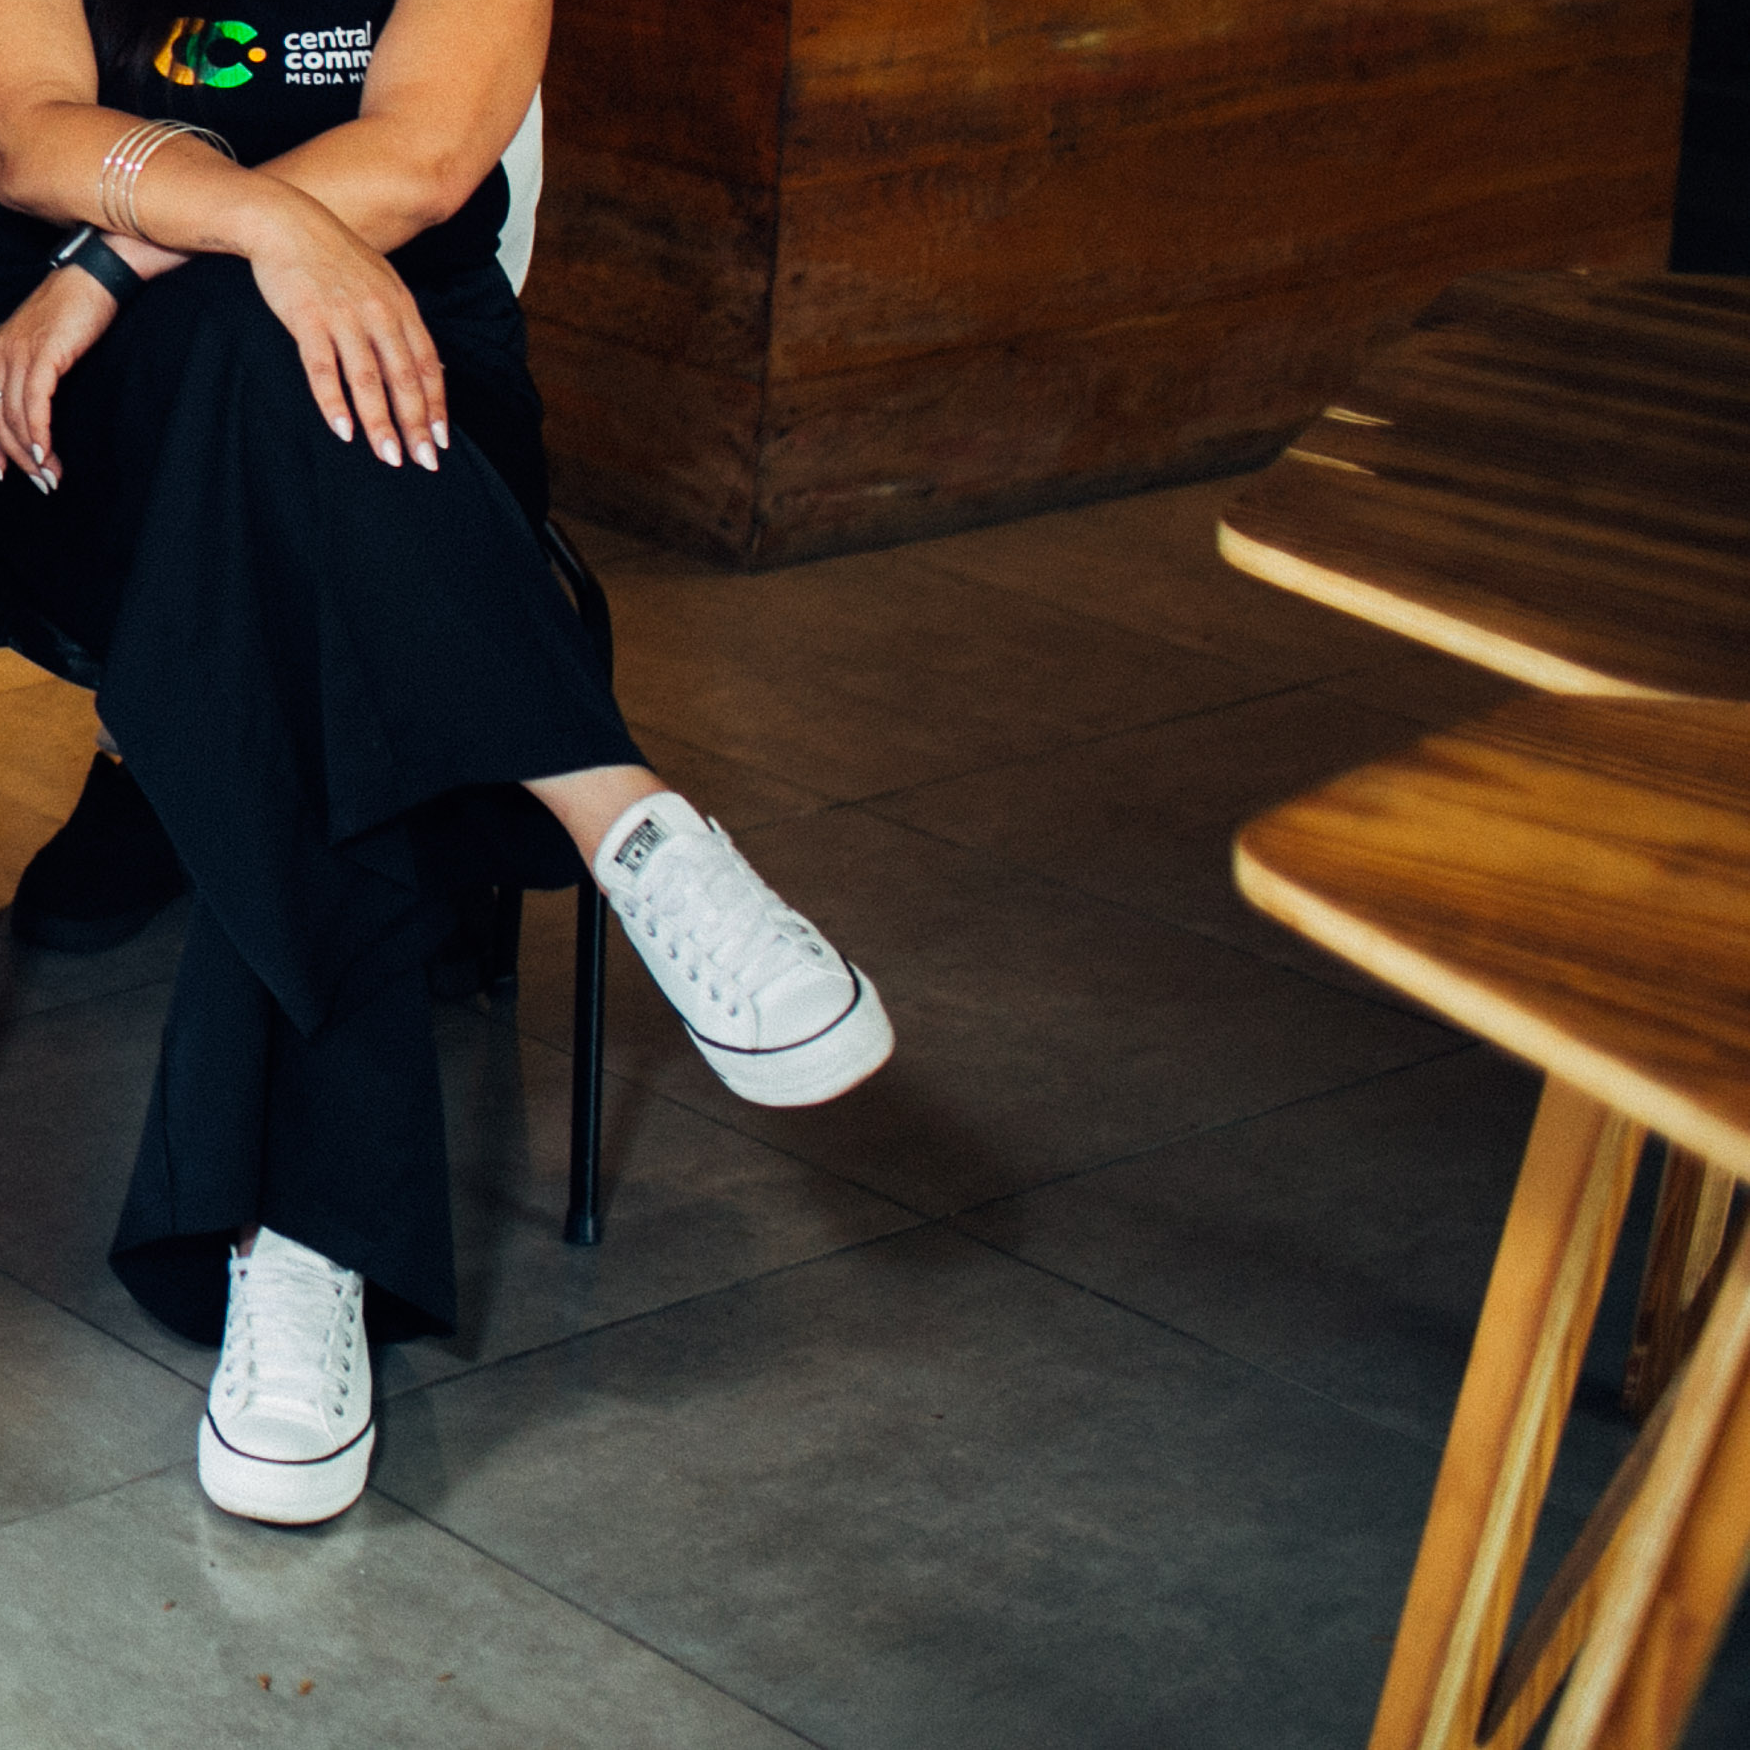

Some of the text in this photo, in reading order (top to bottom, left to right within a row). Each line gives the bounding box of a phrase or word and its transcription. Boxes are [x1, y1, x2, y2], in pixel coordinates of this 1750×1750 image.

[284, 20, 371, 51] central
[284, 50, 372, 70] comm
[285, 72, 344, 84] MEDIA
